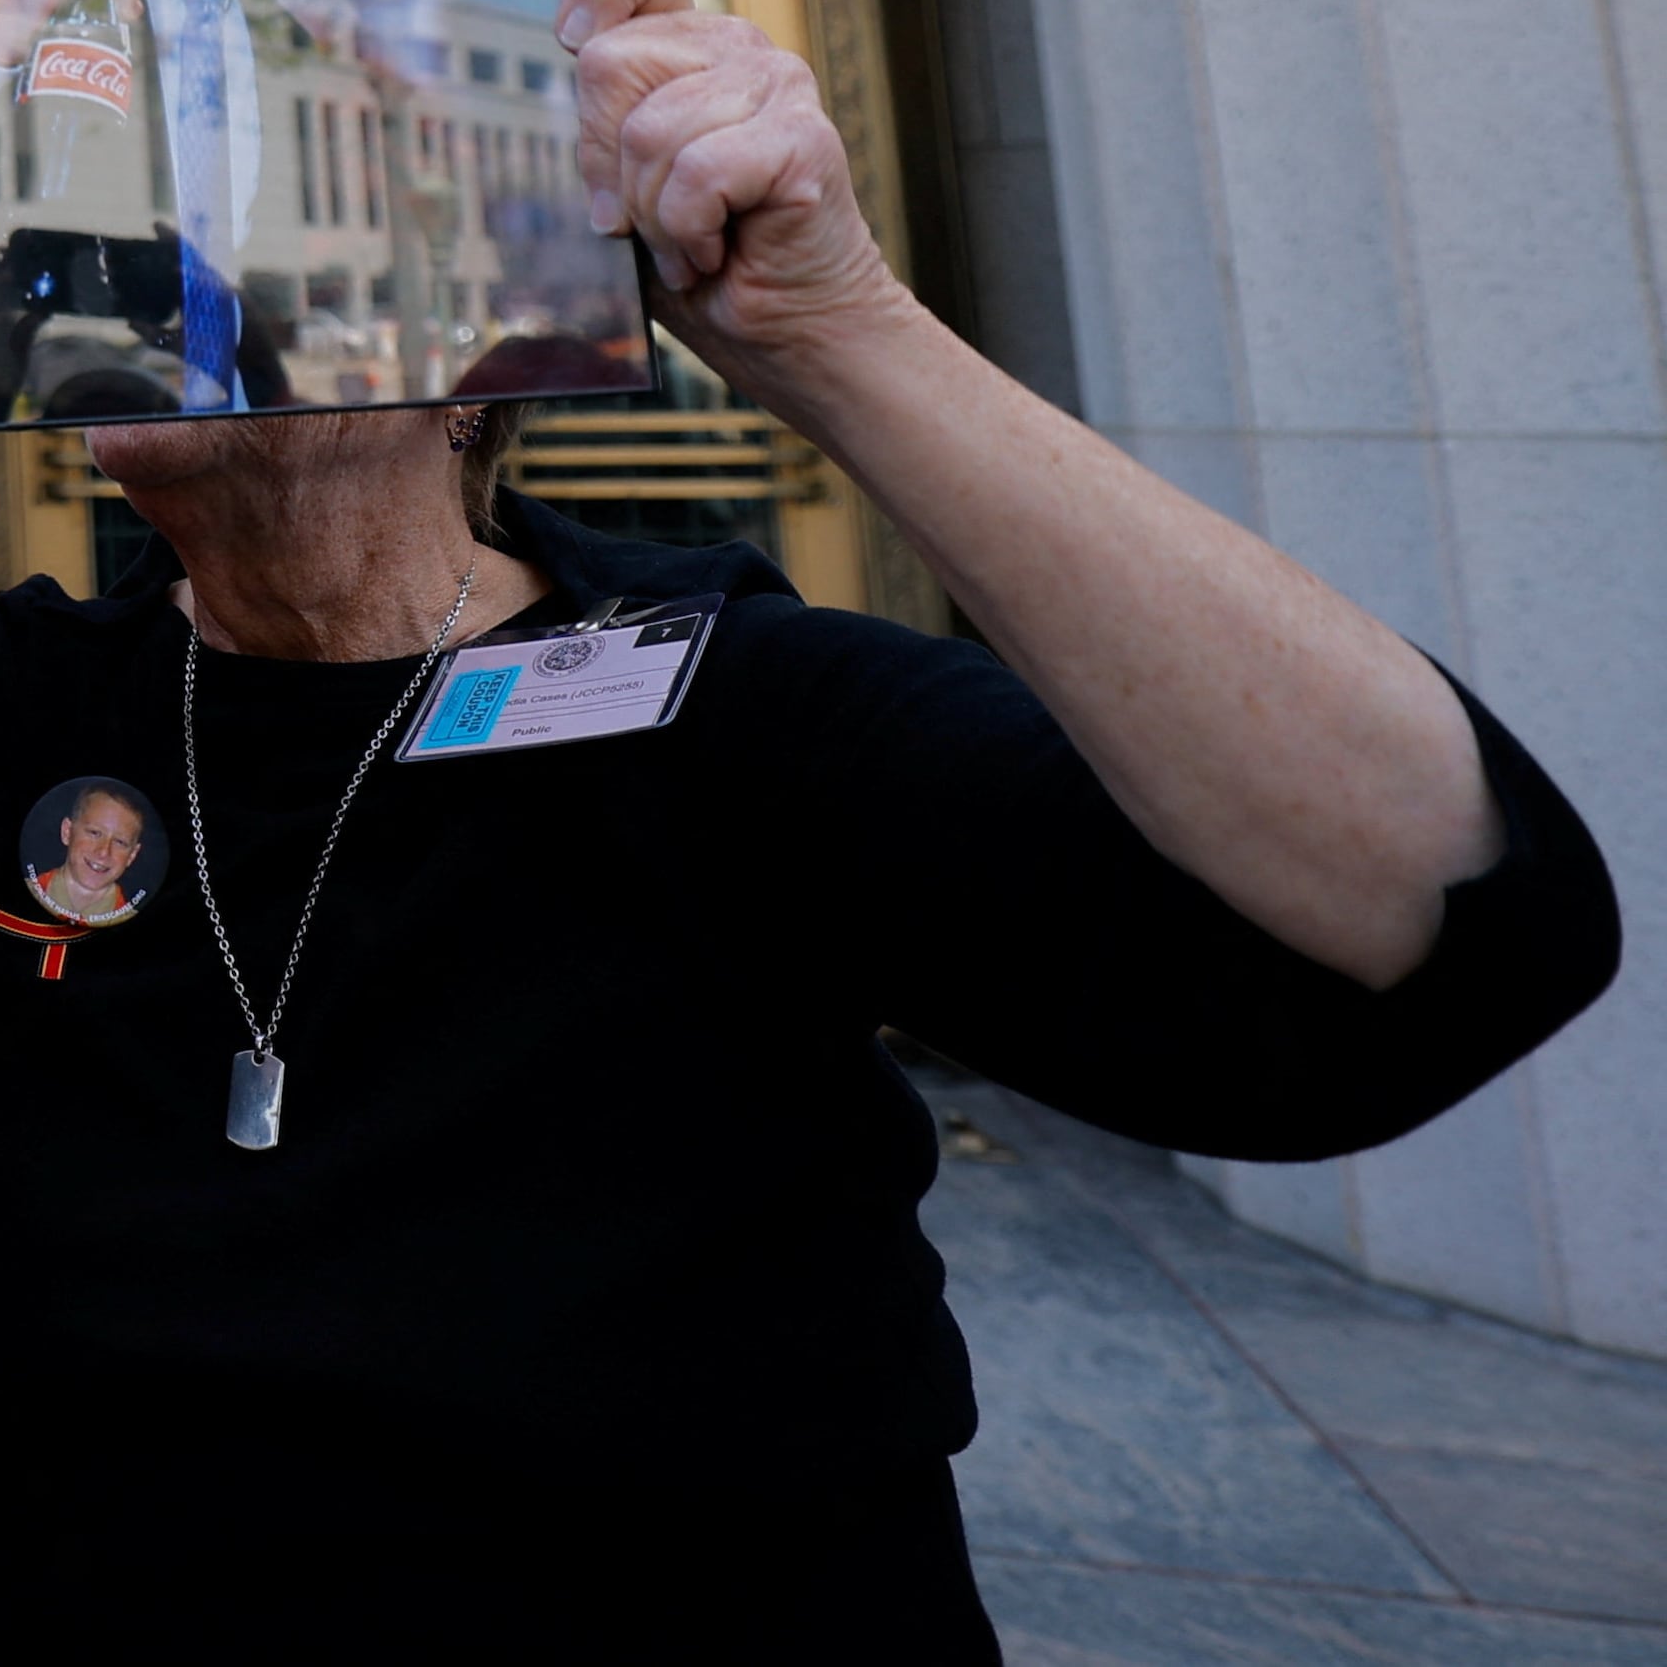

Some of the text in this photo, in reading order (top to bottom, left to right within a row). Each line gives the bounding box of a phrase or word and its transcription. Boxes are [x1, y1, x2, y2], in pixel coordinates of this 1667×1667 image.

[660, 627, 673, 639] 7
[456, 680, 490, 729] COUPON
[467, 673, 507, 733] KEEP THIS
[530, 692, 568, 704] Cases
[511, 724, 552, 738] Public
[26, 863, 39, 883] STOP
[88, 889, 147, 923] ERIKSCAUSE.ORG
